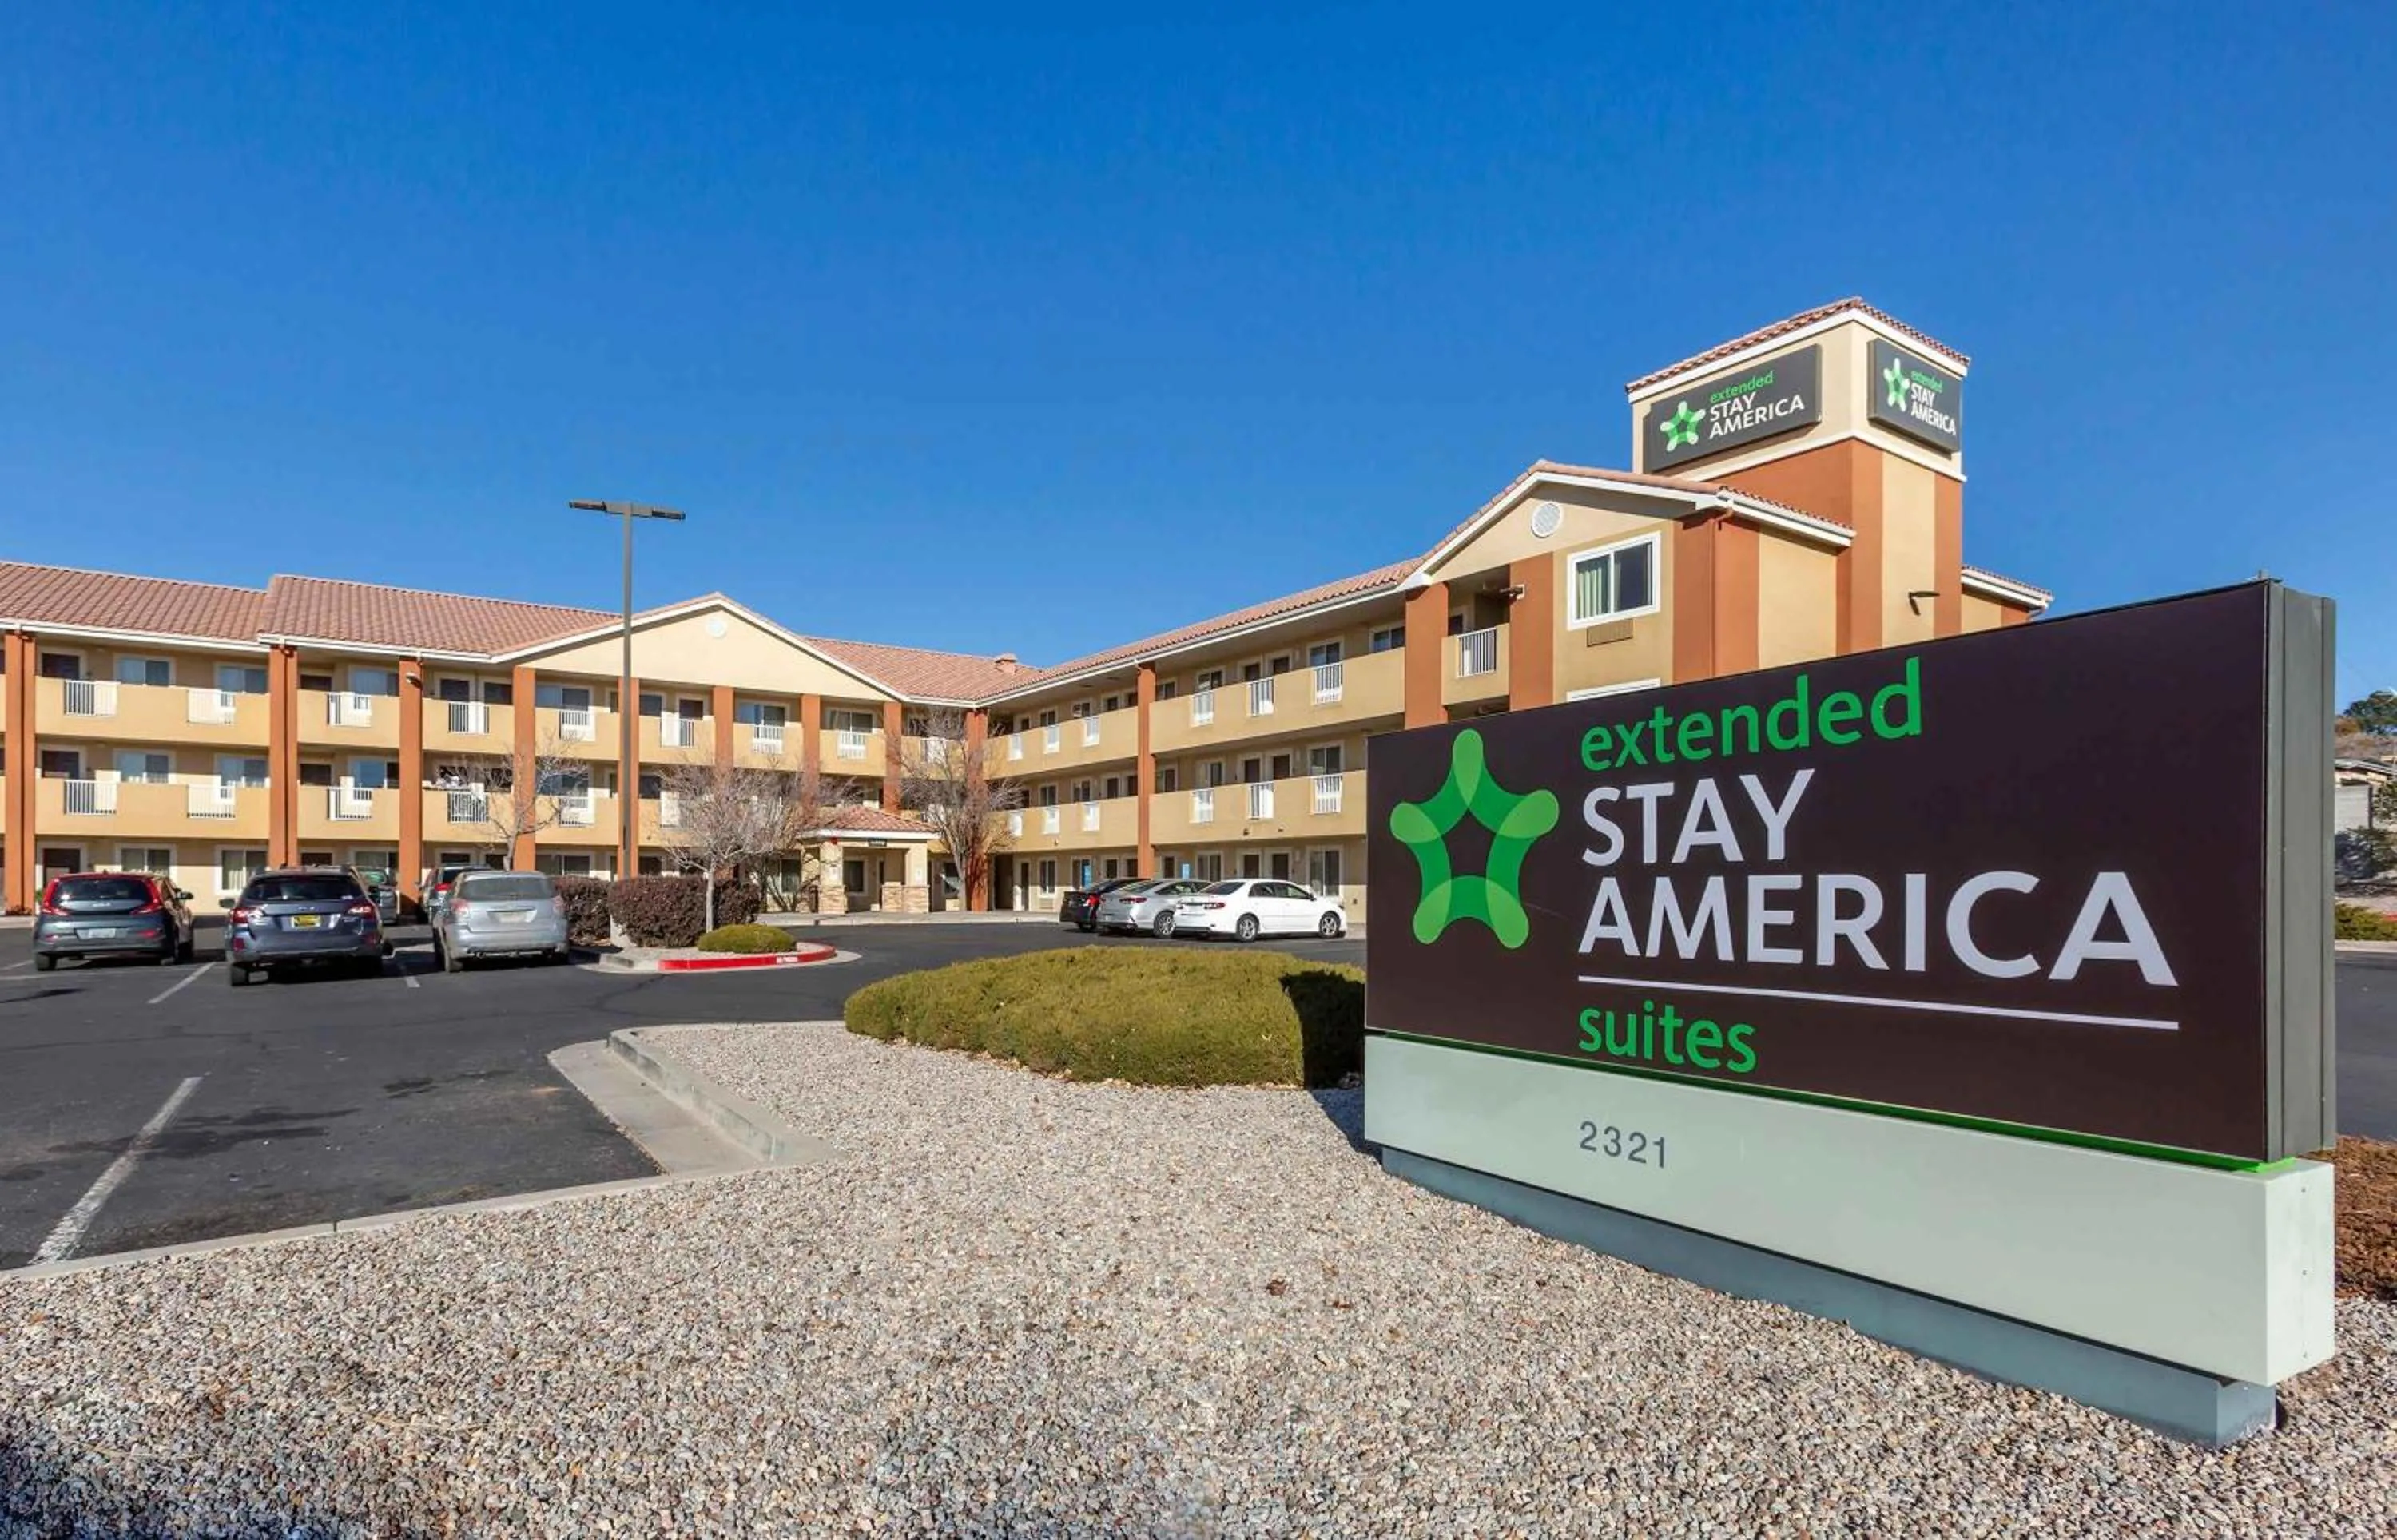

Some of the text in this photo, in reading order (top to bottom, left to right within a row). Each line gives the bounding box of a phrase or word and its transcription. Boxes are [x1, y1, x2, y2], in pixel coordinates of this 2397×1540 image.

[1710, 370, 1774, 403] extended
[1710, 391, 1756, 422] STAY
[1910, 382, 1935, 407] STAY
[1709, 394, 1805, 439] AMERICA
[1910, 400, 1957, 435] AMERICA
[1580, 657, 1922, 772] extended
[1582, 768, 1815, 866] STAY
[1578, 871, 2179, 986] AMERICA
[1579, 1000, 1757, 1073] suites
[1580, 1121, 1667, 1169] 2321
